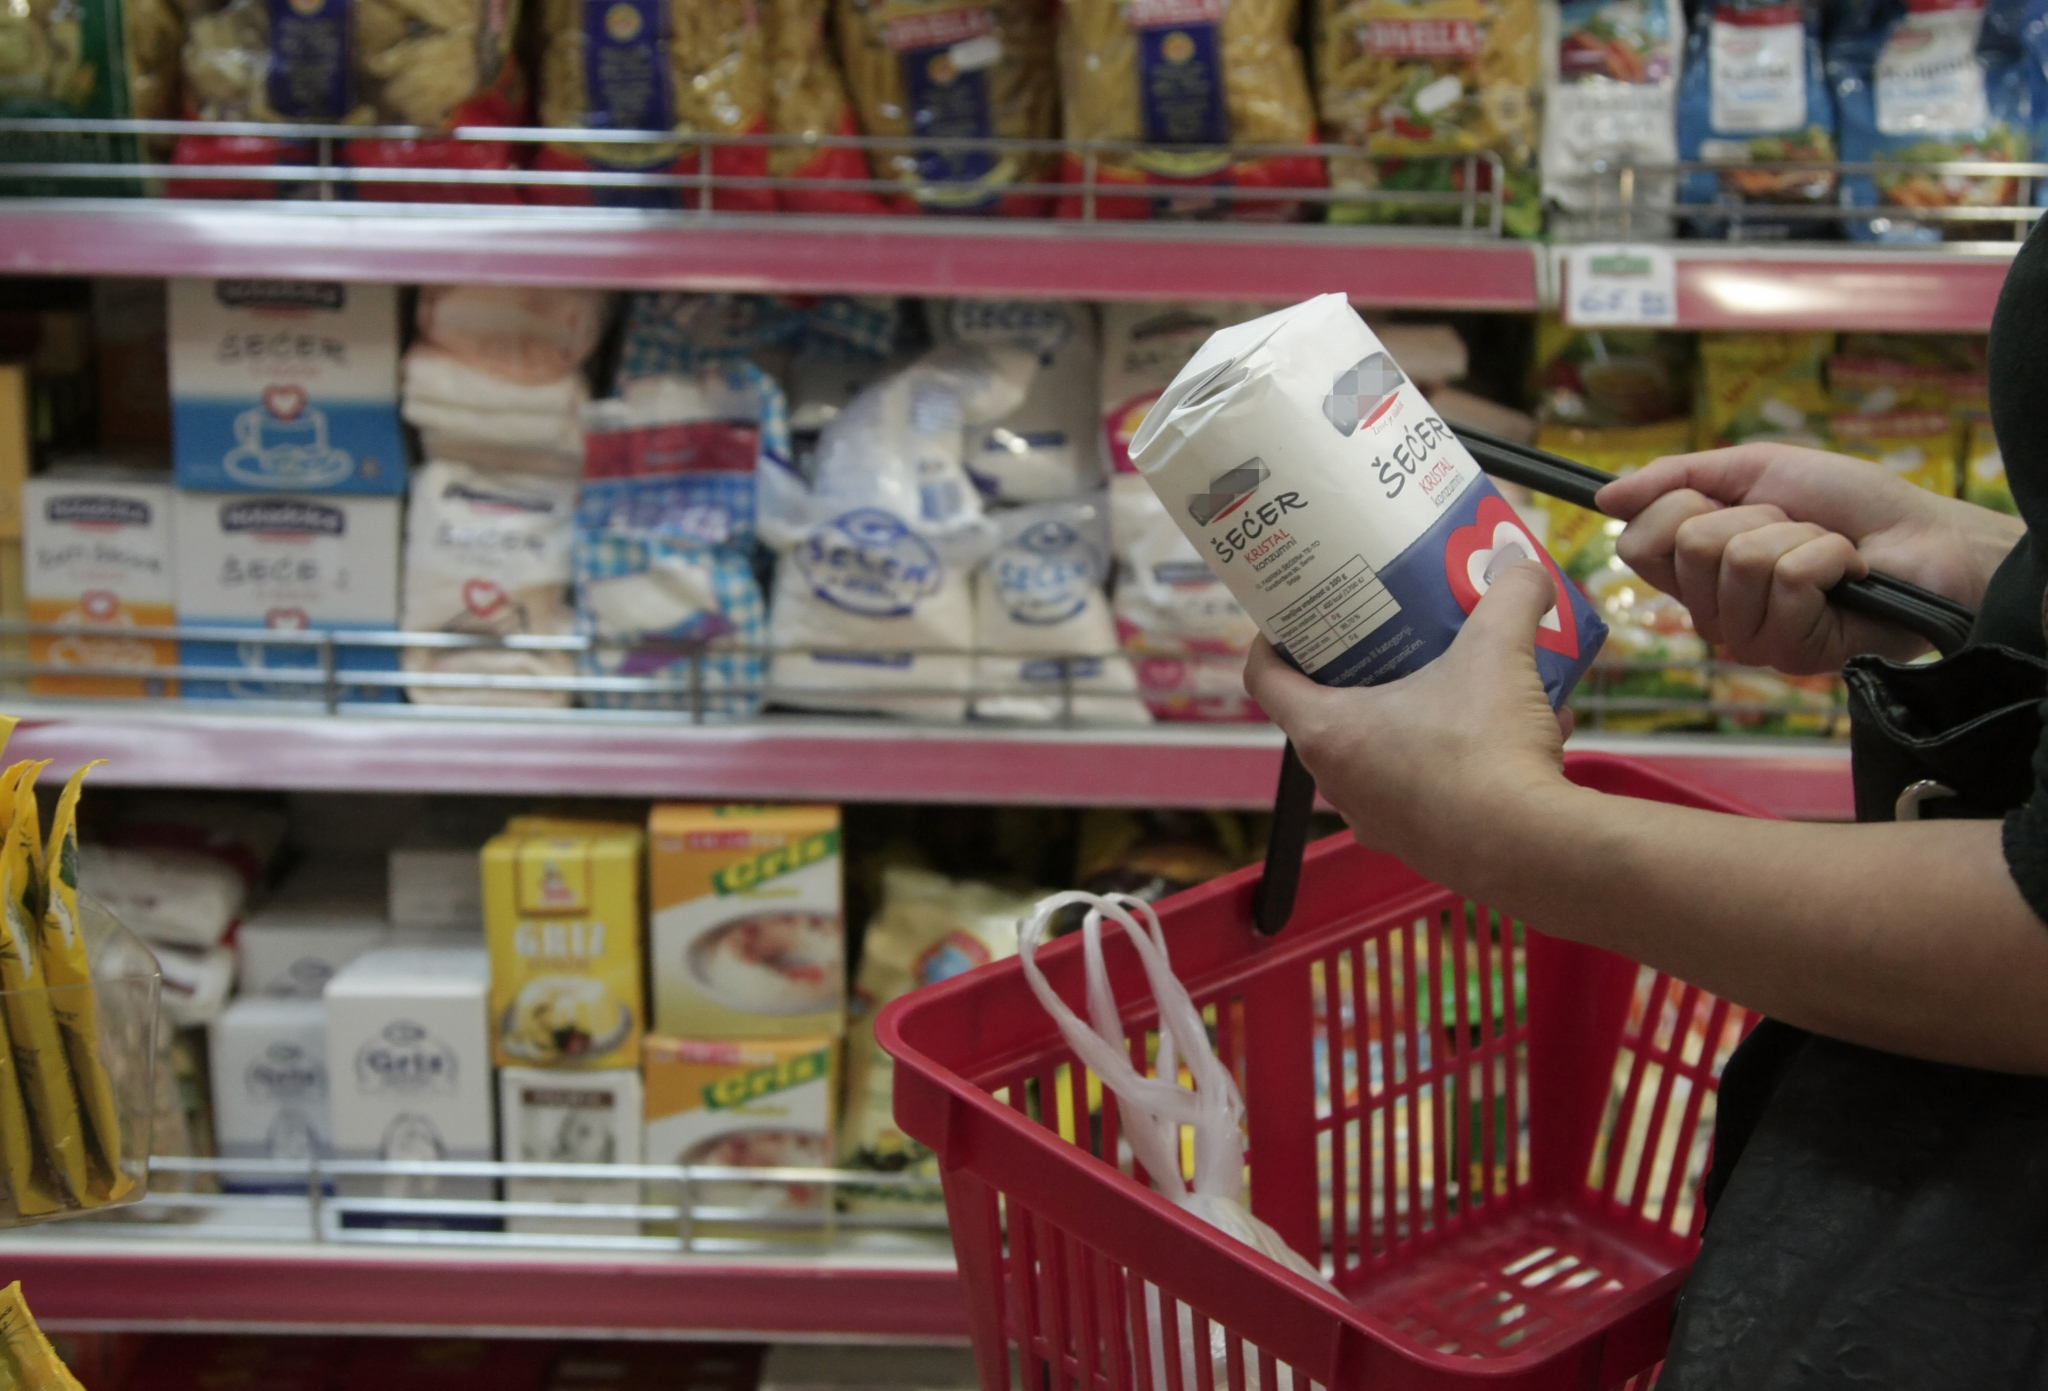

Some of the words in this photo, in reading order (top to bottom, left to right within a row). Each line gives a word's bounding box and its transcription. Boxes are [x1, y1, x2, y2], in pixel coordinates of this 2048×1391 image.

[1371, 416, 1454, 499] ŠEĆER
[1418, 456, 1456, 495] KRISTAL
[1430, 469, 1466, 508] konzumni
[1210, 491, 1308, 564] ŠEĆER
[1244, 528, 1290, 564] KRISTAL
[1252, 536, 1298, 572] konzumni
[1302, 540, 1321, 556] TE-TO
[1329, 575, 1341, 588] 100
